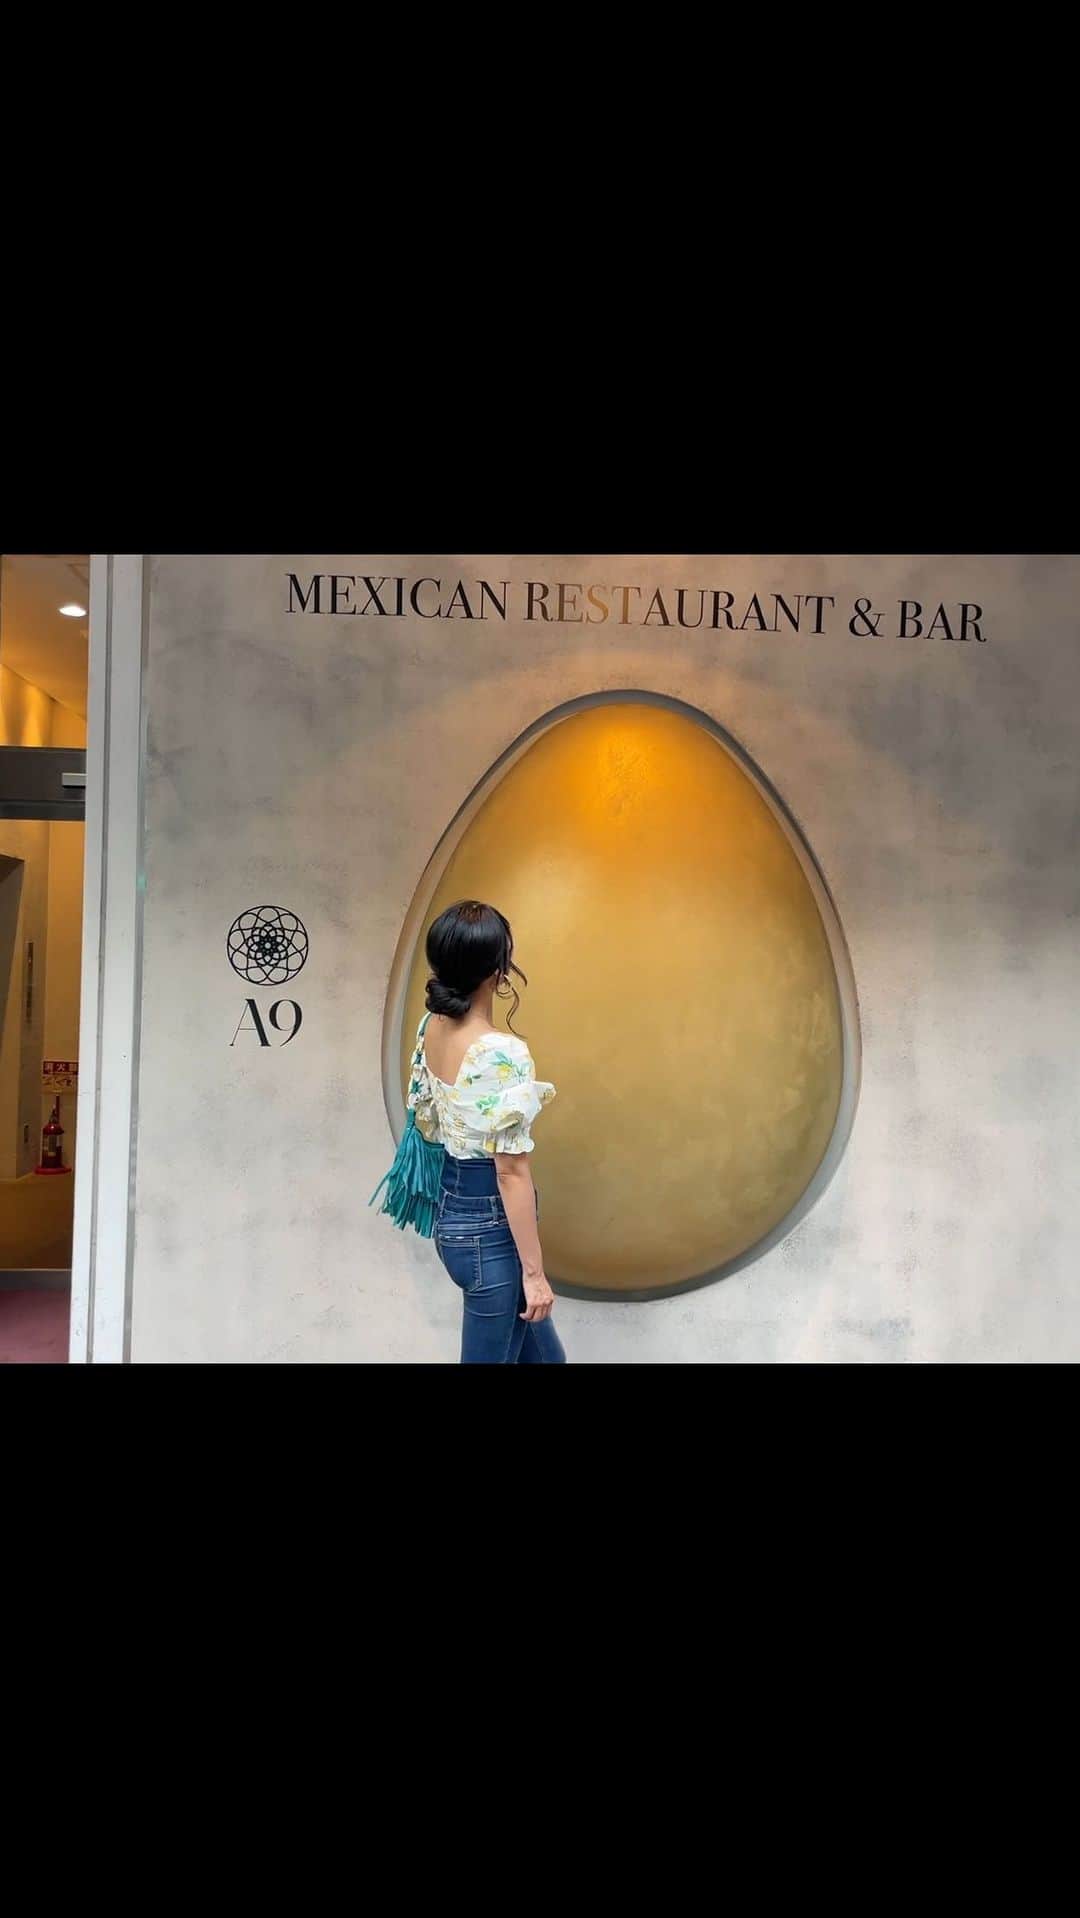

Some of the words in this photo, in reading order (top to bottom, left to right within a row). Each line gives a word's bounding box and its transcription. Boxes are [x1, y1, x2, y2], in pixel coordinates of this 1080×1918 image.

[285, 573, 511, 621] MEXICAN
[523, 581, 835, 635] RESTAURANT
[848, 597, 886, 638] &
[897, 600, 987, 643] BAR
[229, 998, 303, 1047] A9
